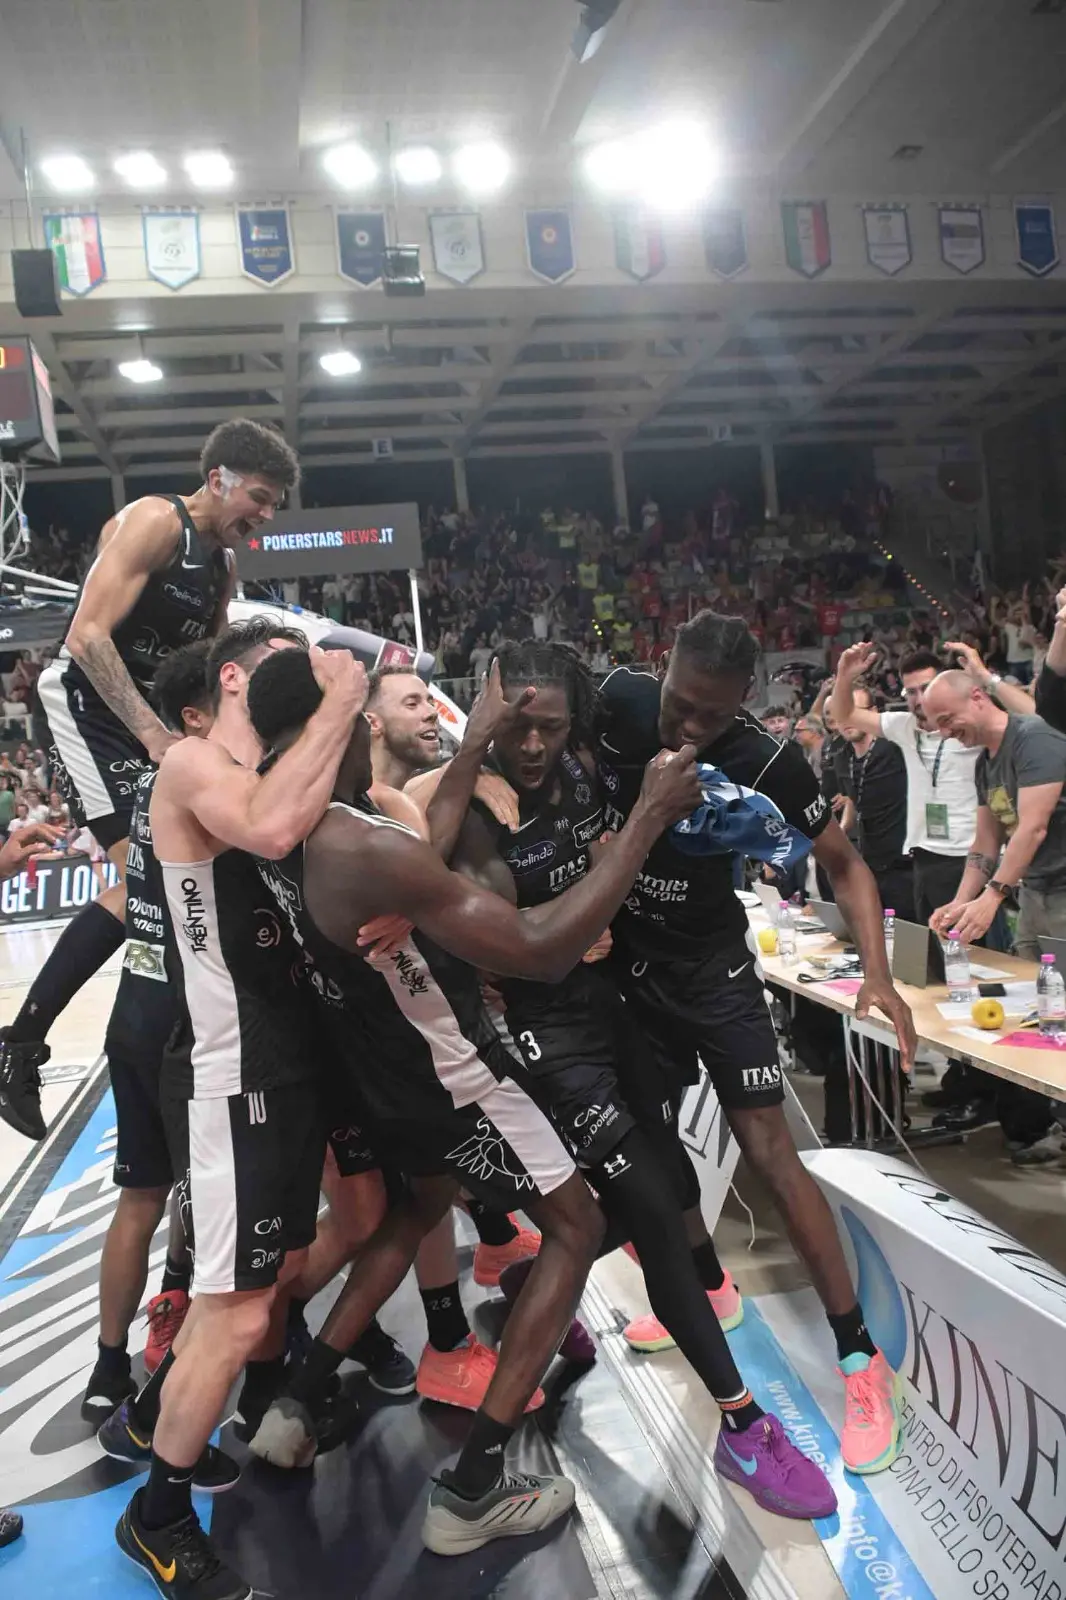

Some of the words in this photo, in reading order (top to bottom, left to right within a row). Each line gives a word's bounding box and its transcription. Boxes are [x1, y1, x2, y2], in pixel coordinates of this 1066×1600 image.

[262, 527, 394, 551] POKERSTARSNEWS.IT
[549, 854, 587, 888] ITAS
[1, 868, 53, 914] GET
[634, 883, 688, 902] nergia
[519, 1030, 542, 1061] 3
[741, 1064, 781, 1087] ITAS
[900, 1280, 1066, 1552] KINE
[937, 1457, 963, 1491] DI
[888, 1450, 932, 1506] CINA
[920, 1498, 983, 1574] DELLO
